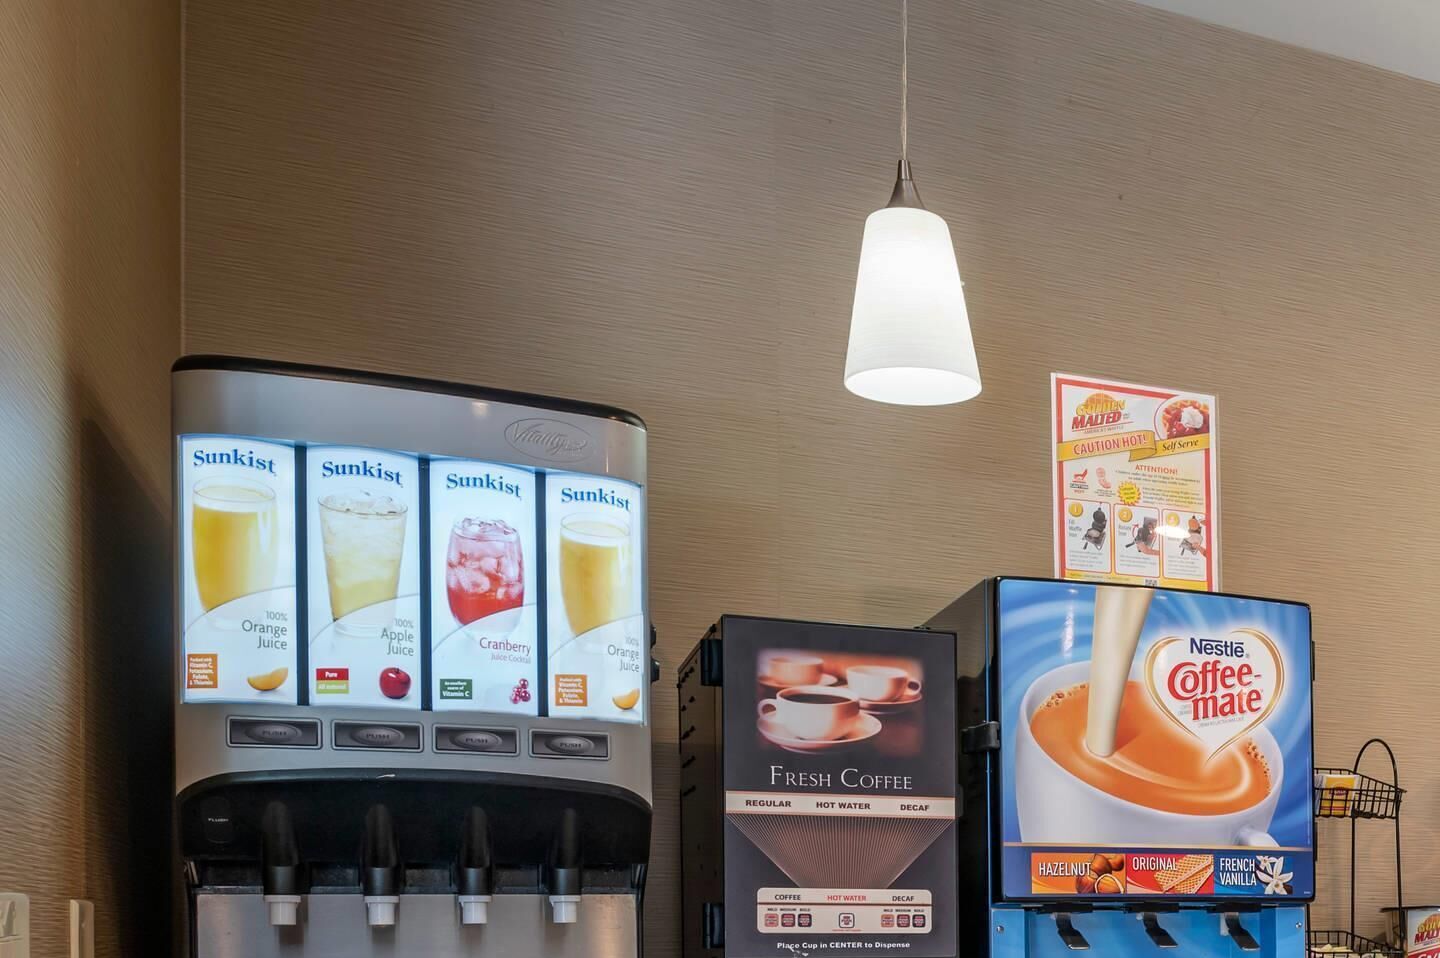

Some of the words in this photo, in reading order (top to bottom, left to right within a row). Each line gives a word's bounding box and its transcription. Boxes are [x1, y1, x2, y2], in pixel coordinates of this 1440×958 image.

[1076, 400, 1126, 416] GOLDEN
[1071, 411, 1122, 430] MALTED
[1073, 440, 1120, 456] CAUTION
[1122, 434, 1147, 449] HOT!
[1162, 442, 1177, 453] Self
[1178, 439, 1199, 449] Serve
[193, 448, 276, 474] Sunkist
[322, 460, 402, 485] Sunkist
[1135, 464, 1178, 475] ATTENTION!
[446, 473, 521, 498] Sunkist
[561, 488, 631, 512] Sunkist
[265, 610, 288, 621] 100%
[241, 619, 288, 639] Orange
[395, 618, 414, 629] 100%
[257, 635, 288, 650] Juice
[381, 627, 414, 644] Apple
[386, 641, 414, 656] Juice
[479, 636, 531, 656] Cranberry
[607, 644, 640, 661] Orange
[491, 653, 507, 662] Juice
[508, 653, 532, 664] Cocktail
[619, 660, 640, 673] Juice
[325, 671, 338, 679] Pure
[1191, 688, 1262, 720] mate
[770, 765, 831, 787] FRESH
[840, 768, 912, 790] COFFEE
[745, 800, 791, 808] REGULAR
[816, 801, 836, 809] HOT
[838, 802, 871, 810] WATER
[1038, 862, 1091, 876] HAZELNUT
[1132, 857, 1177, 871] ORIGINAL
[1219, 858, 1255, 872] FRENCH
[1219, 872, 1257, 886] VANILLA
